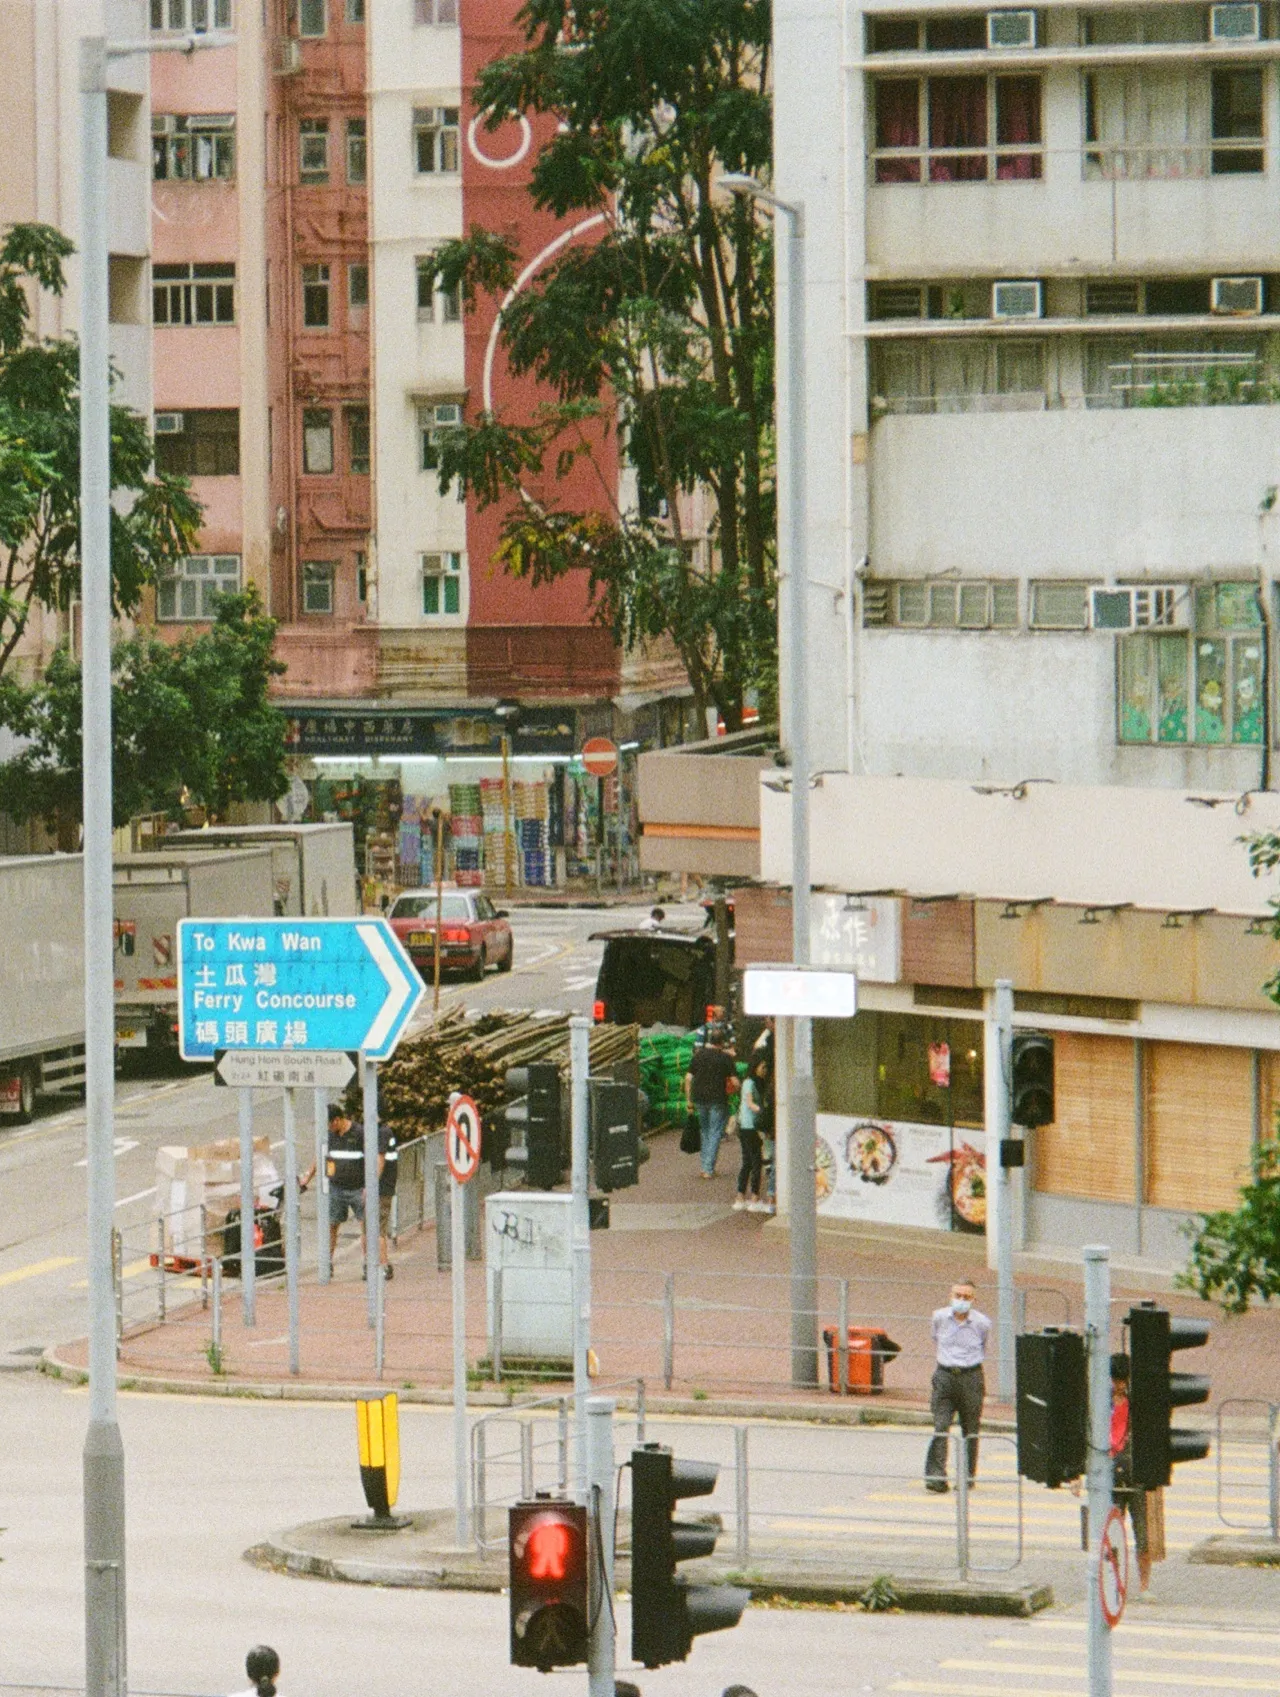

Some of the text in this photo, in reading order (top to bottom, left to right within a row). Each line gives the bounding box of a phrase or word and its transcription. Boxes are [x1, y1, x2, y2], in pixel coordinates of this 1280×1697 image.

[193, 932, 322, 951] To Kwa Wan
[194, 962, 277, 988] 土瓜灣
[194, 991, 356, 1013] Ferry Concourse
[195, 1020, 308, 1045] 碼頭廣場
[231, 1055, 343, 1067] Hung Hom South Road
